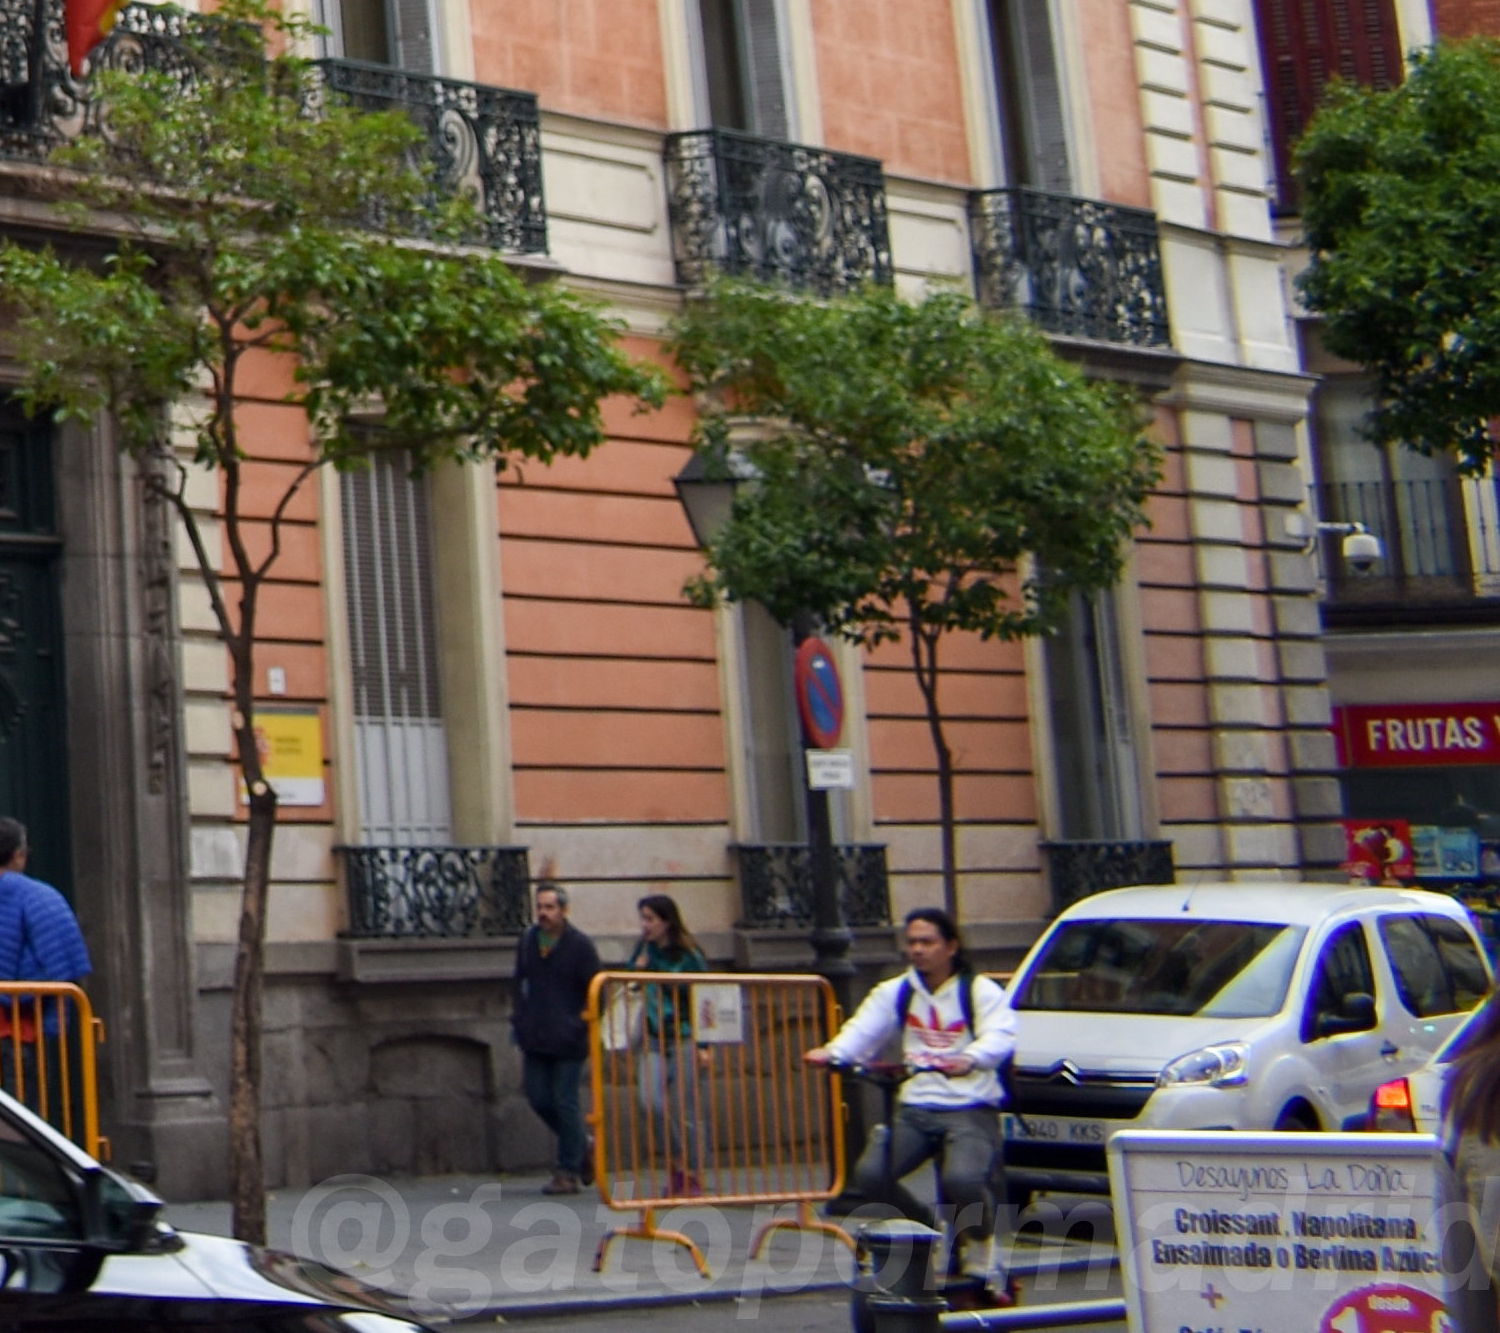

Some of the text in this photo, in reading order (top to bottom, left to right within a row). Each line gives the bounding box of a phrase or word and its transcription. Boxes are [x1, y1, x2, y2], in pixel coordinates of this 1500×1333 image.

[1366, 716, 1484, 751] FRUTAS
[1303, 1162, 1341, 1190] La
[1152, 1238, 1272, 1268] Ensaimada
[1276, 1246, 1290, 1269] o
[1293, 1243, 1378, 1271] Berlina
